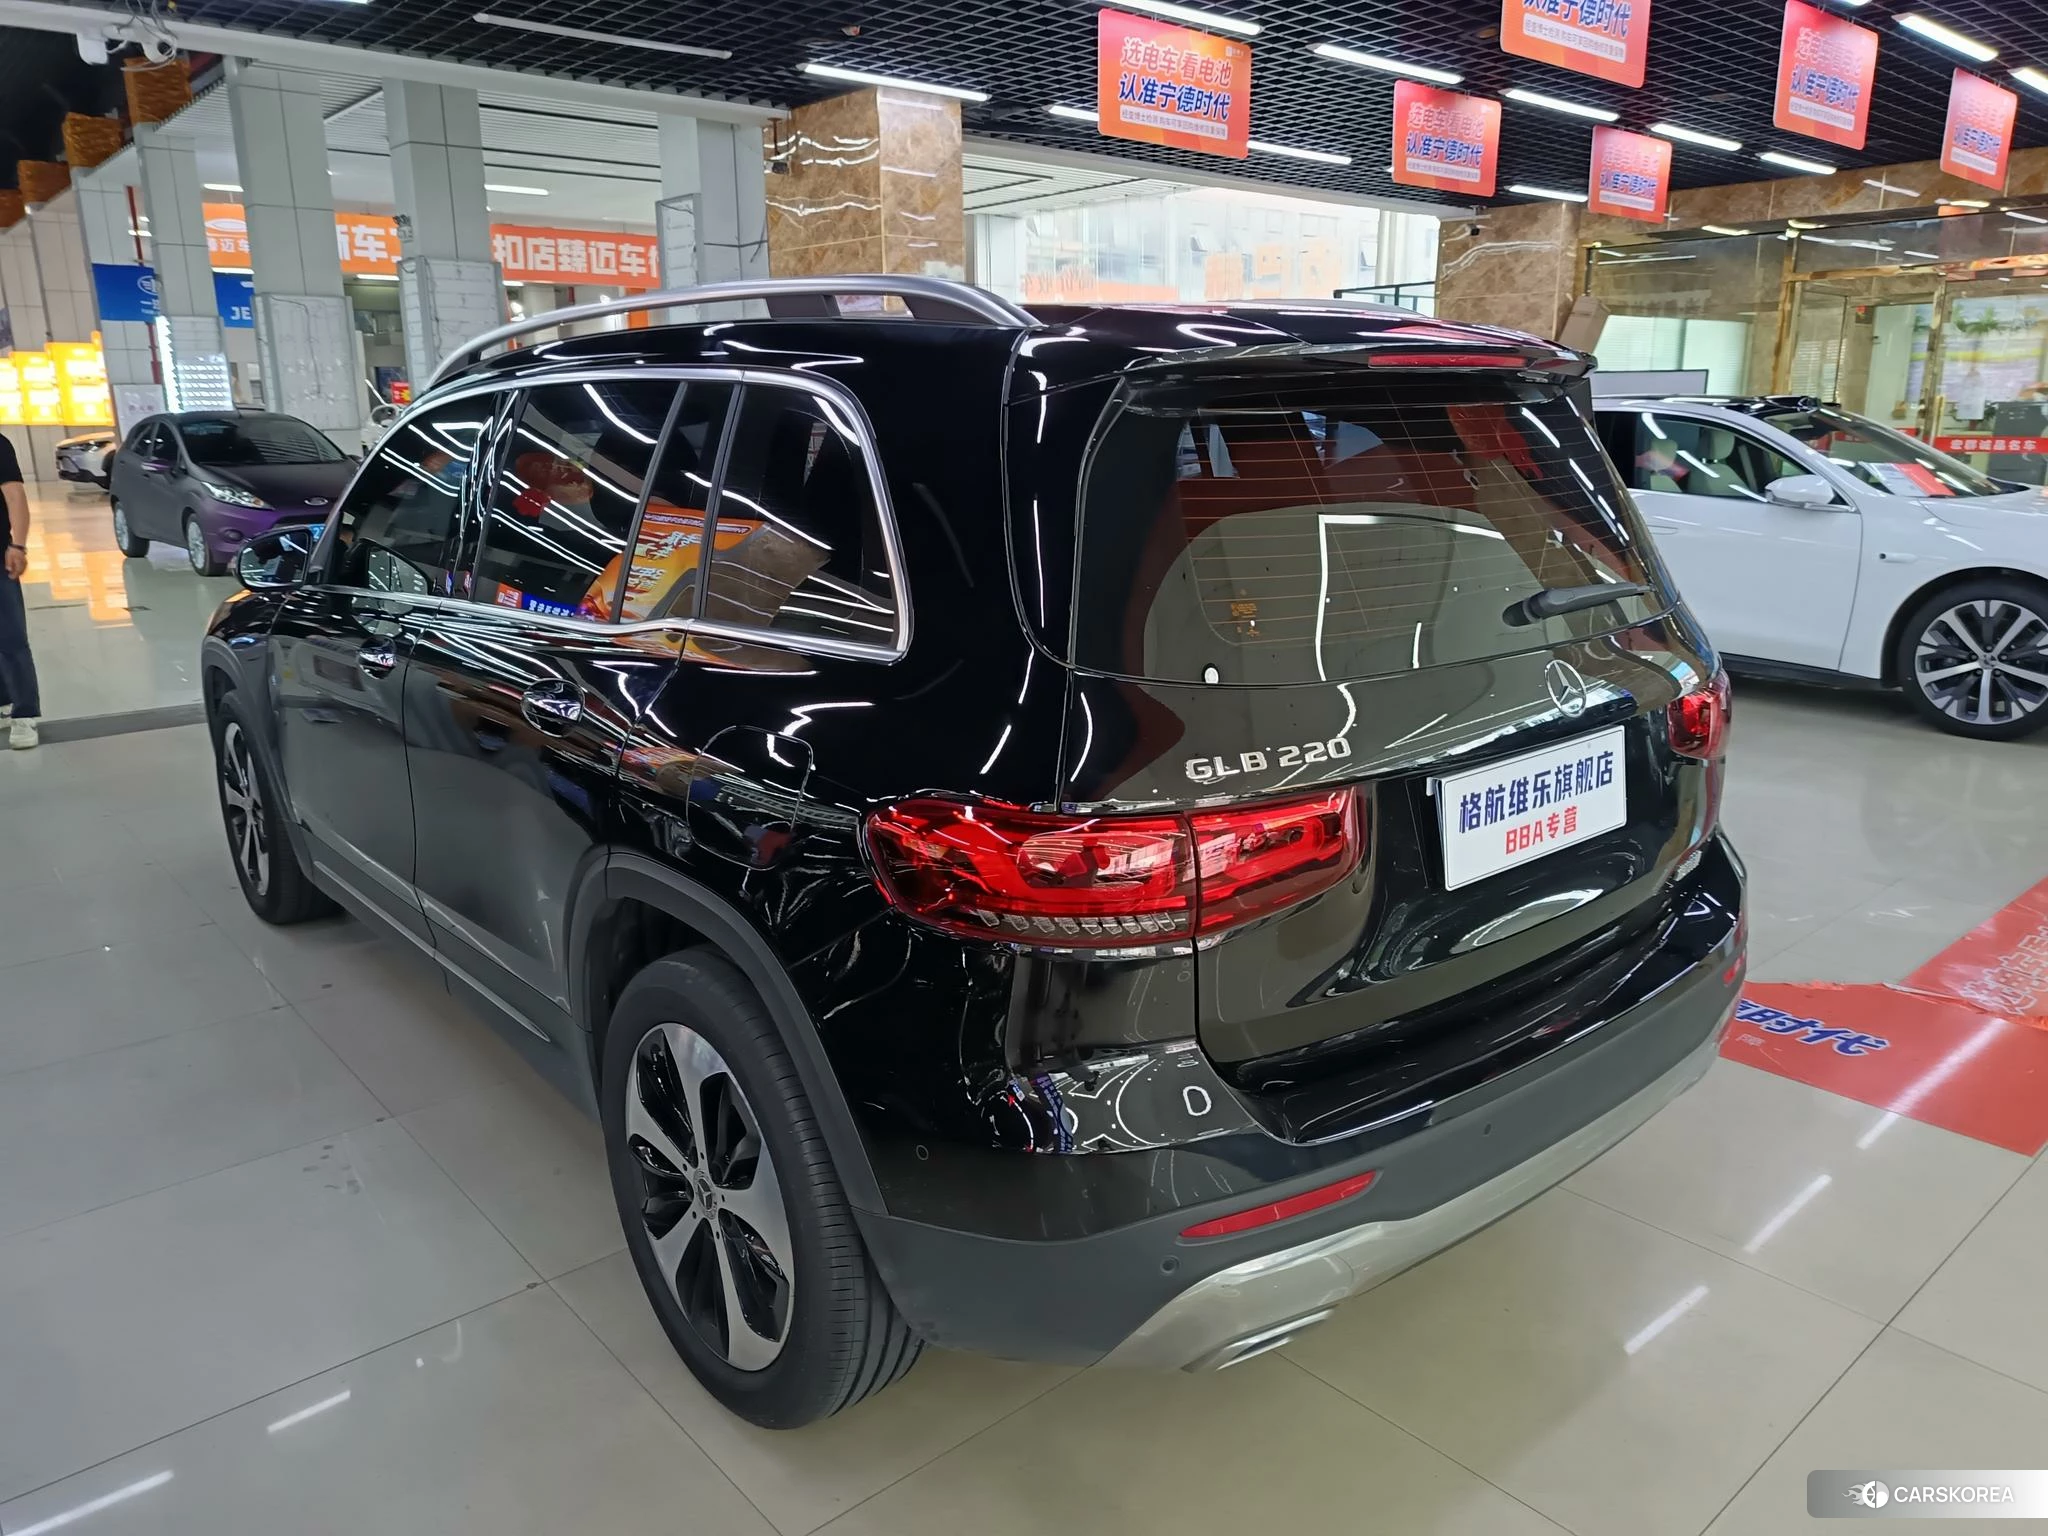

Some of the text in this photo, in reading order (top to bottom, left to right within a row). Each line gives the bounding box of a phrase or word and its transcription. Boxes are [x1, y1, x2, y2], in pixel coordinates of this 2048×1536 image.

[1119, 73, 1230, 120] 认准宁德时代
[1406, 131, 1483, 167] 认准宁德时代
[1186, 737, 1351, 780] GLB 220
[1459, 751, 1613, 833] 格航维乐旗舰店
[1505, 806, 1578, 855] BBA专营
